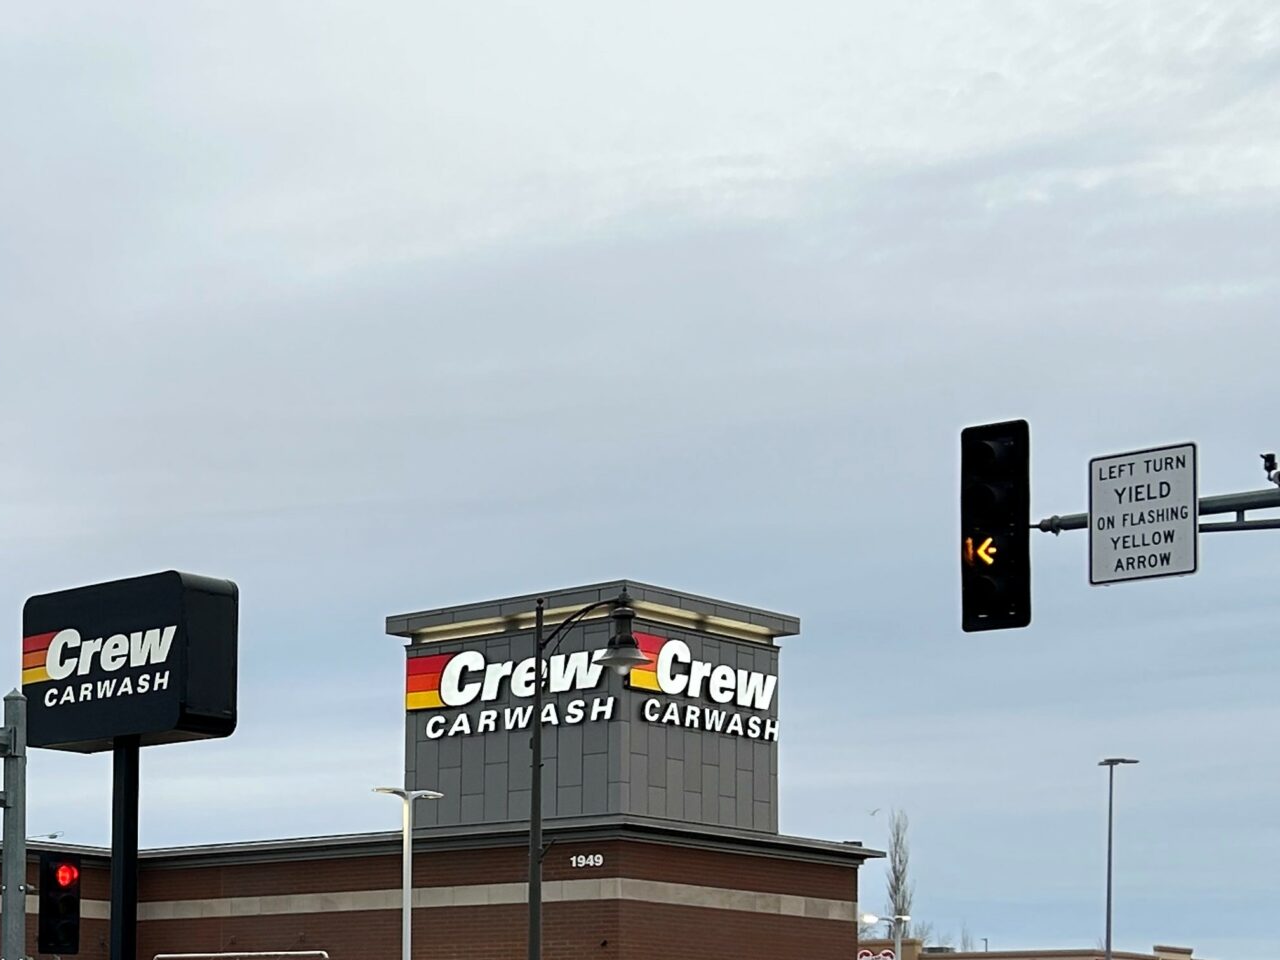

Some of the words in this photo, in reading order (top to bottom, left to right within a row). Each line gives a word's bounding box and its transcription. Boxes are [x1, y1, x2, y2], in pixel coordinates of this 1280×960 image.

[1099, 462, 1135, 481] LEFT
[1143, 455, 1186, 474] TURN
[1114, 481, 1171, 504] YIELD
[1097, 515, 1115, 531] ON
[1122, 505, 1188, 527] FLASHING
[1110, 529, 1174, 550] YELLOW
[1114, 551, 1171, 573] ARROW
[46, 625, 177, 680] Crew
[44, 670, 170, 707] CARWASH
[440, 649, 607, 706] Crew
[656, 639, 777, 710] Crew
[425, 696, 614, 739] CARWASH
[644, 698, 780, 741] CARWASH
[570, 854, 604, 868] 1949
